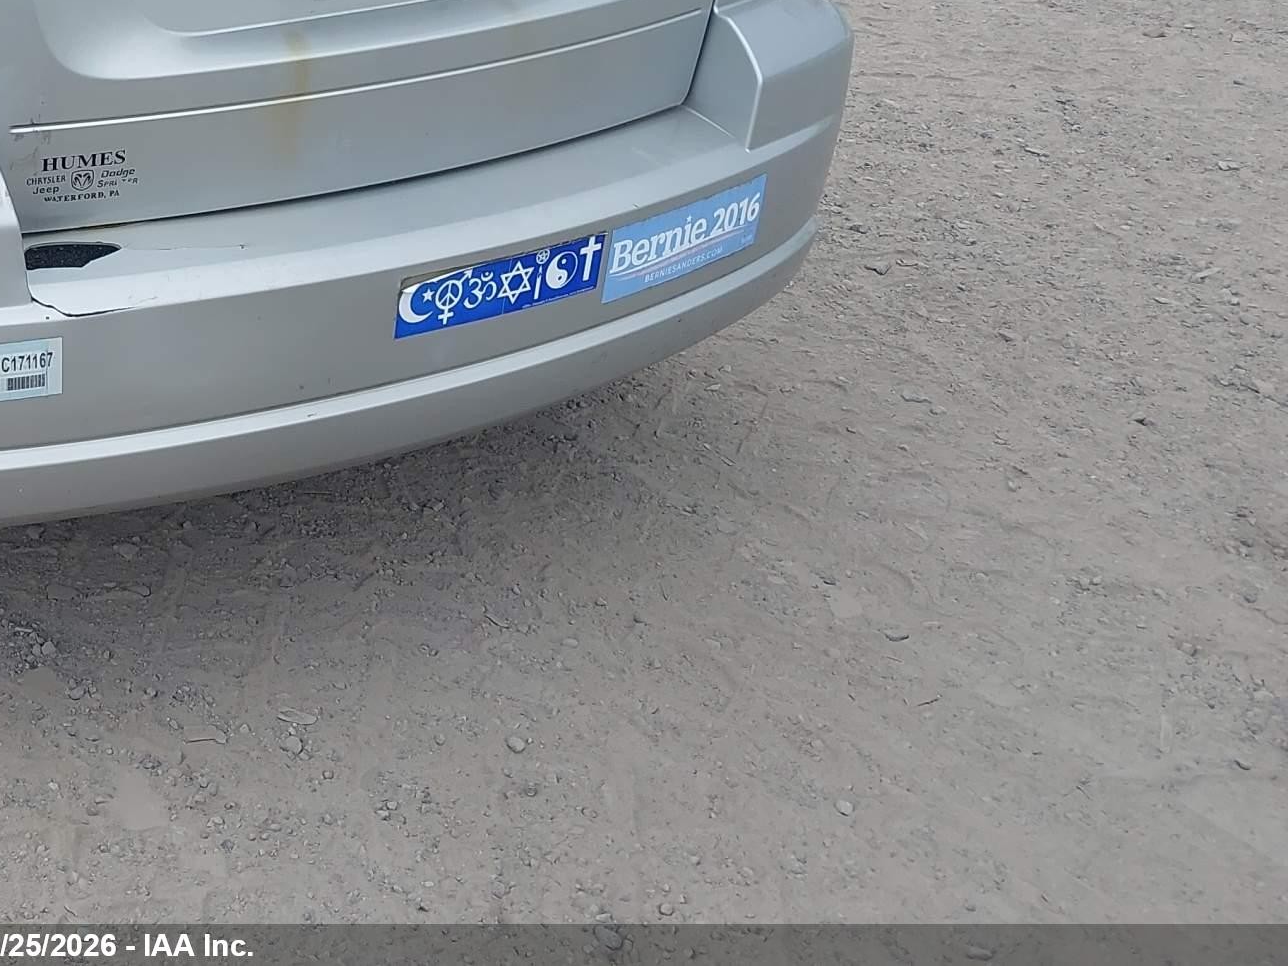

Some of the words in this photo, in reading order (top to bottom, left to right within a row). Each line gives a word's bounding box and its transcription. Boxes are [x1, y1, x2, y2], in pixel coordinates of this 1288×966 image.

[40, 150, 126, 172] HUMES
[26, 175, 66, 186] CHRYSLER
[101, 168, 135, 178] Dodge
[33, 186, 60, 194] Jeep
[610, 215, 707, 274] Bernie
[710, 192, 761, 236] 2016
[1, 352, 53, 373] C171167
